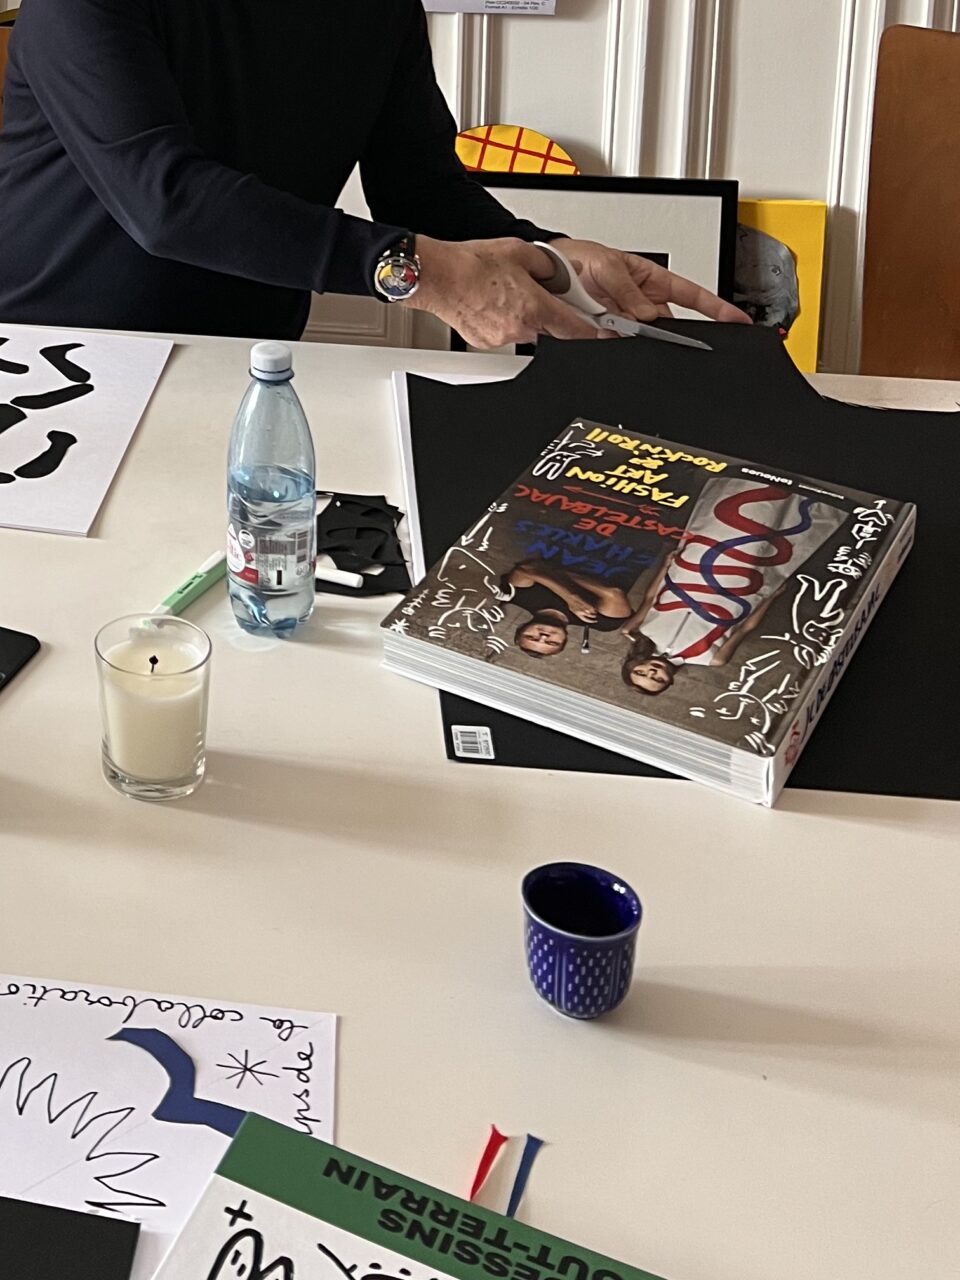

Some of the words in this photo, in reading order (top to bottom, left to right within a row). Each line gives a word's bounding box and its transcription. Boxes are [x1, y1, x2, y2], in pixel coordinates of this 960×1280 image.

[605, 463, 670, 484] ART
[513, 484, 697, 542] CASTELBAJAC
[573, 518, 618, 537] DE
[259, 1016, 310, 1042] la
[323, 1156, 625, 1280] UT-TERRAIN
[378, 1206, 540, 1280] ESSINS
